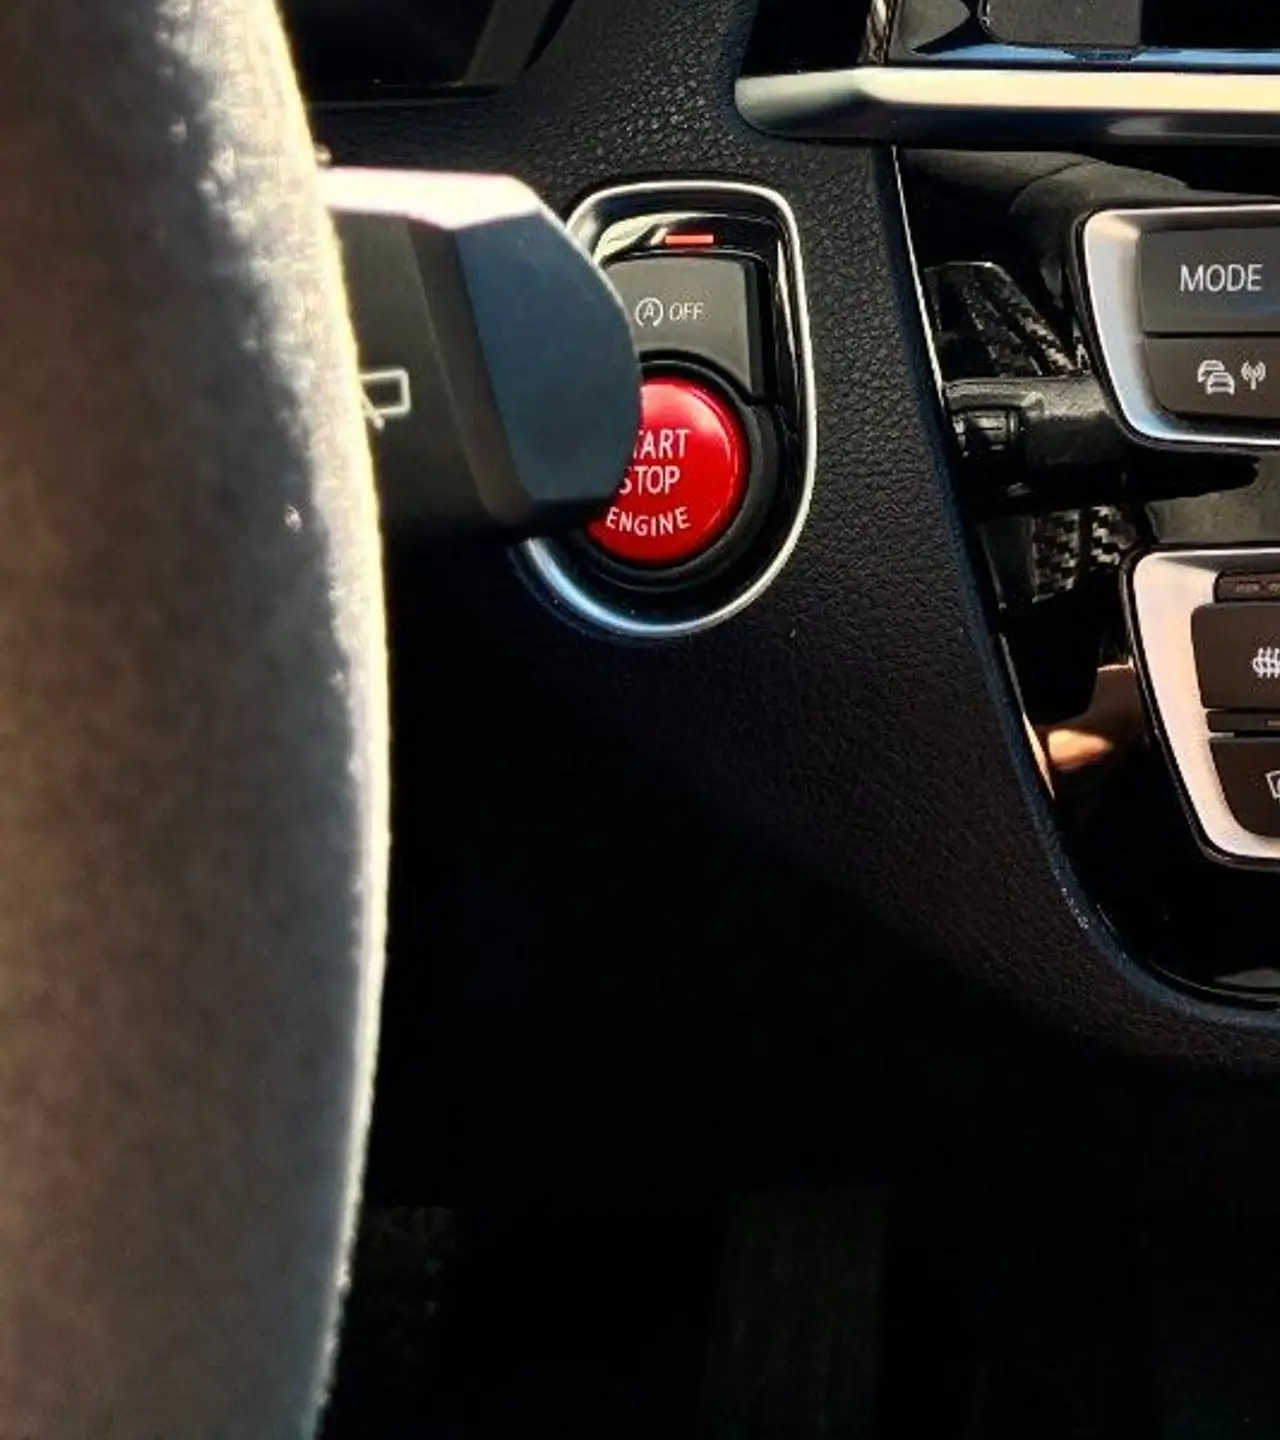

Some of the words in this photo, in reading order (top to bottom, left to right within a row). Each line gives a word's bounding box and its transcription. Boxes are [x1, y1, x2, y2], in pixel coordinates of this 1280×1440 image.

[1178, 263, 1264, 293] MODE
[668, 302, 704, 321] OFF
[605, 505, 693, 538] ENGINE
